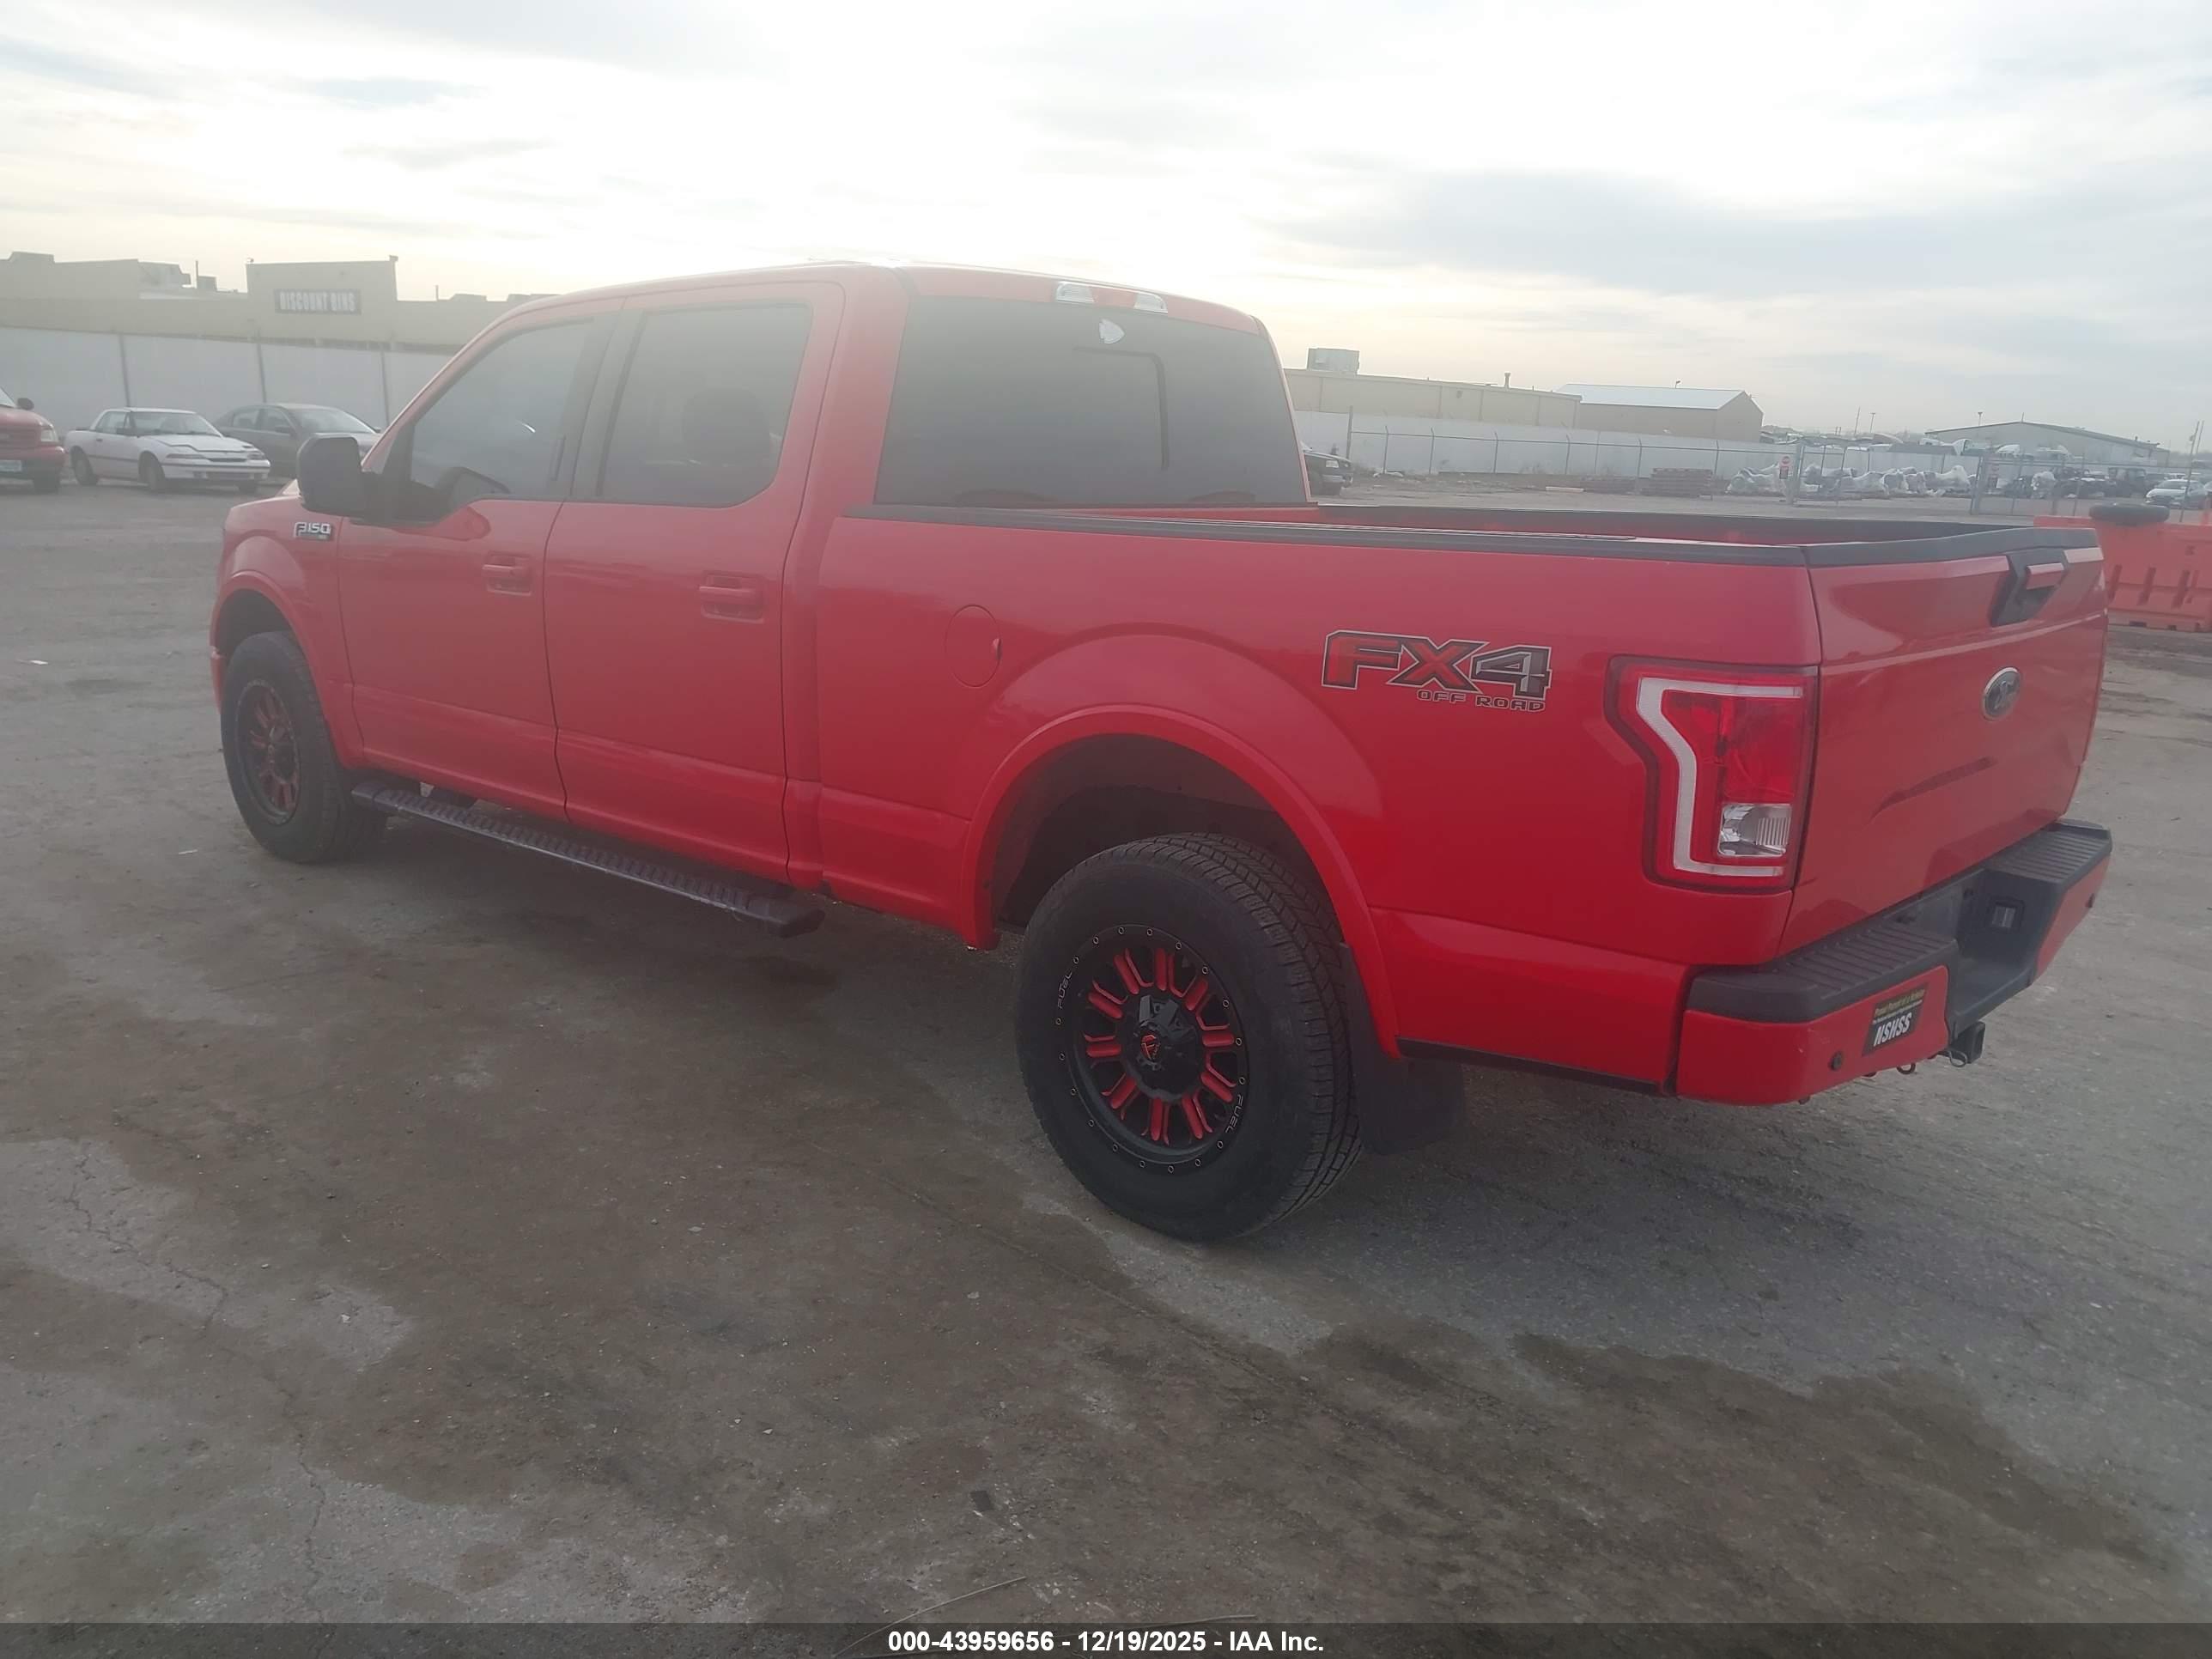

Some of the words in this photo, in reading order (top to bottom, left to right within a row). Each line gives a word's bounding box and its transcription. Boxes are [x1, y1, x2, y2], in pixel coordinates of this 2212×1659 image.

[1322, 629, 1553, 700] FX4
[1417, 689, 1468, 704] OFF
[1474, 695, 1547, 713] ROAD
[1057, 971, 1073, 1010] FUEL
[1224, 1093, 1243, 1133] FUEL
